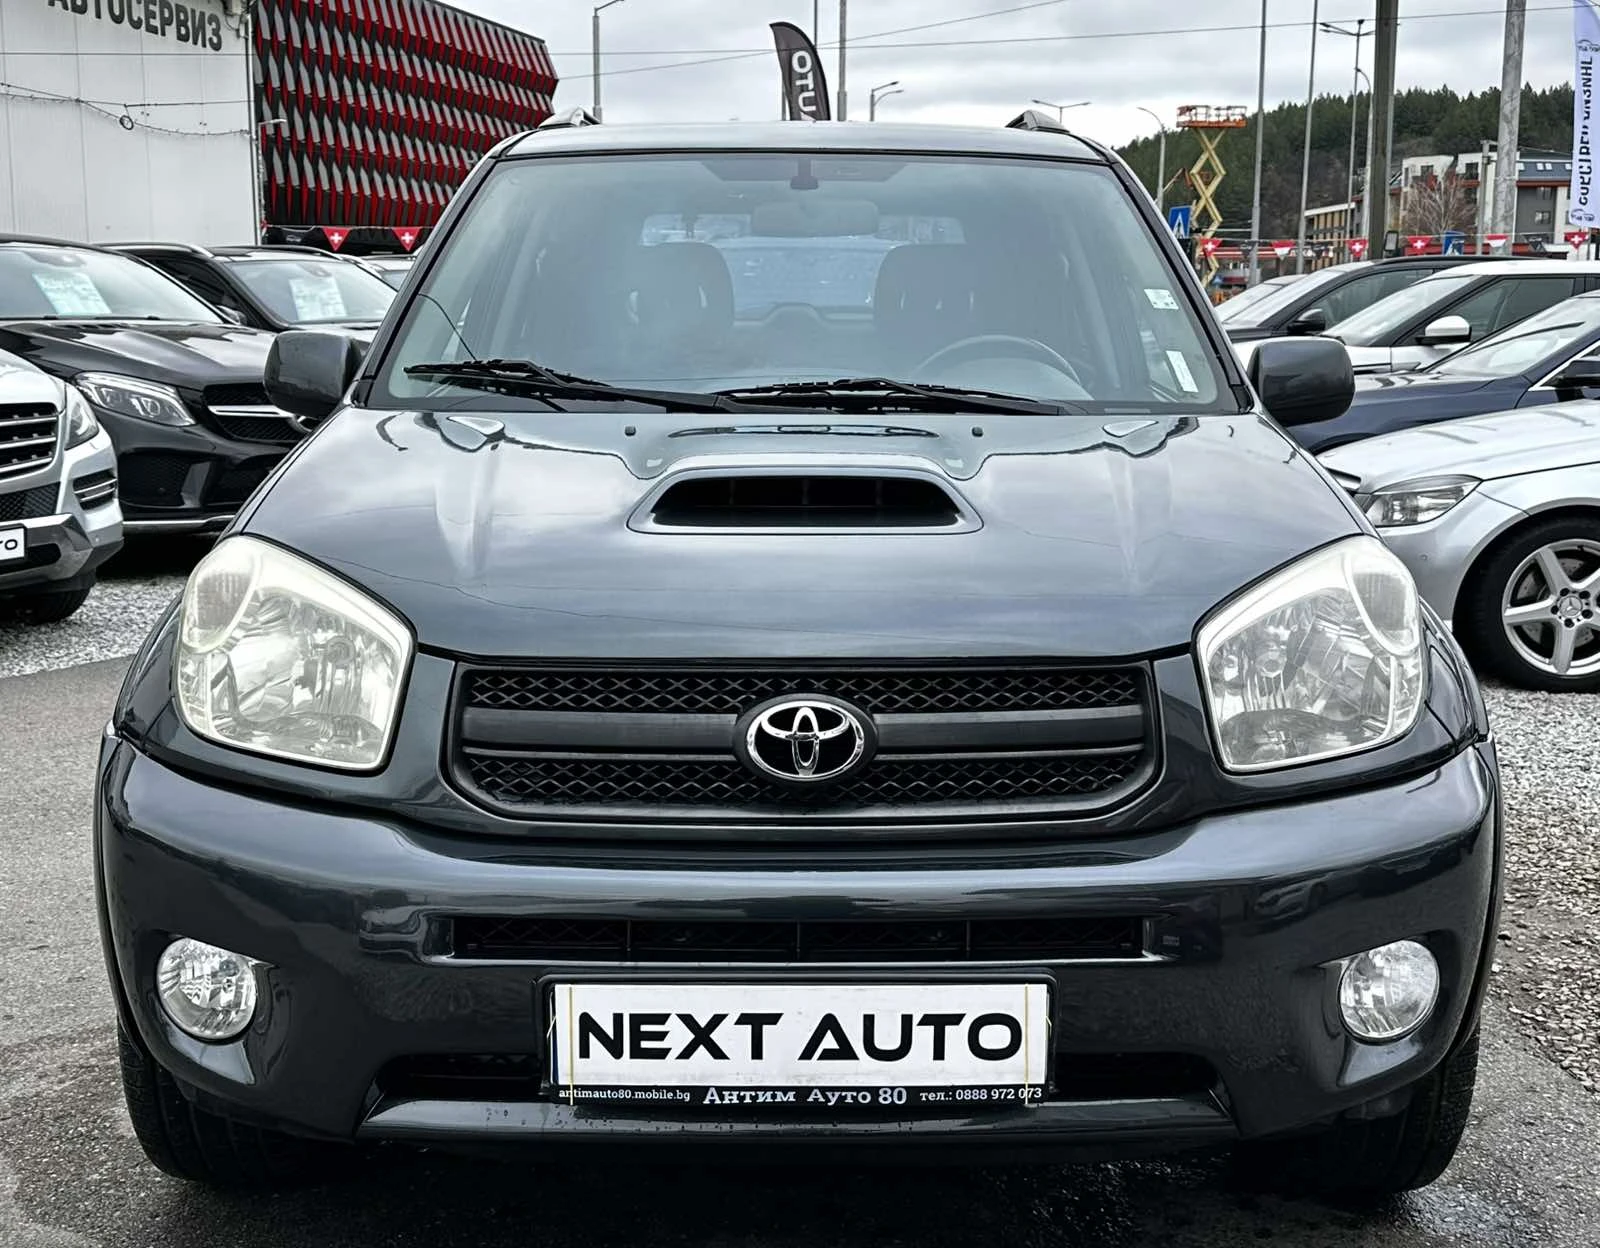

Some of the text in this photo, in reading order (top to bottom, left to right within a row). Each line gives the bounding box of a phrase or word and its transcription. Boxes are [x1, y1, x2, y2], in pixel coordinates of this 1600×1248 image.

[48, 0, 222, 52] ОСЕРВИЗ
[578, 1011, 1023, 1062] NEXT AUTO
[558, 1088, 691, 1102] antimauto80.mobile.bg
[703, 1087, 796, 1105] Антим
[806, 1088, 872, 1106] Ауто
[877, 1087, 908, 1105] 80
[955, 1089, 988, 1101] 0888
[991, 1088, 1015, 1100] 972
[1018, 1087, 1042, 1100] 073
